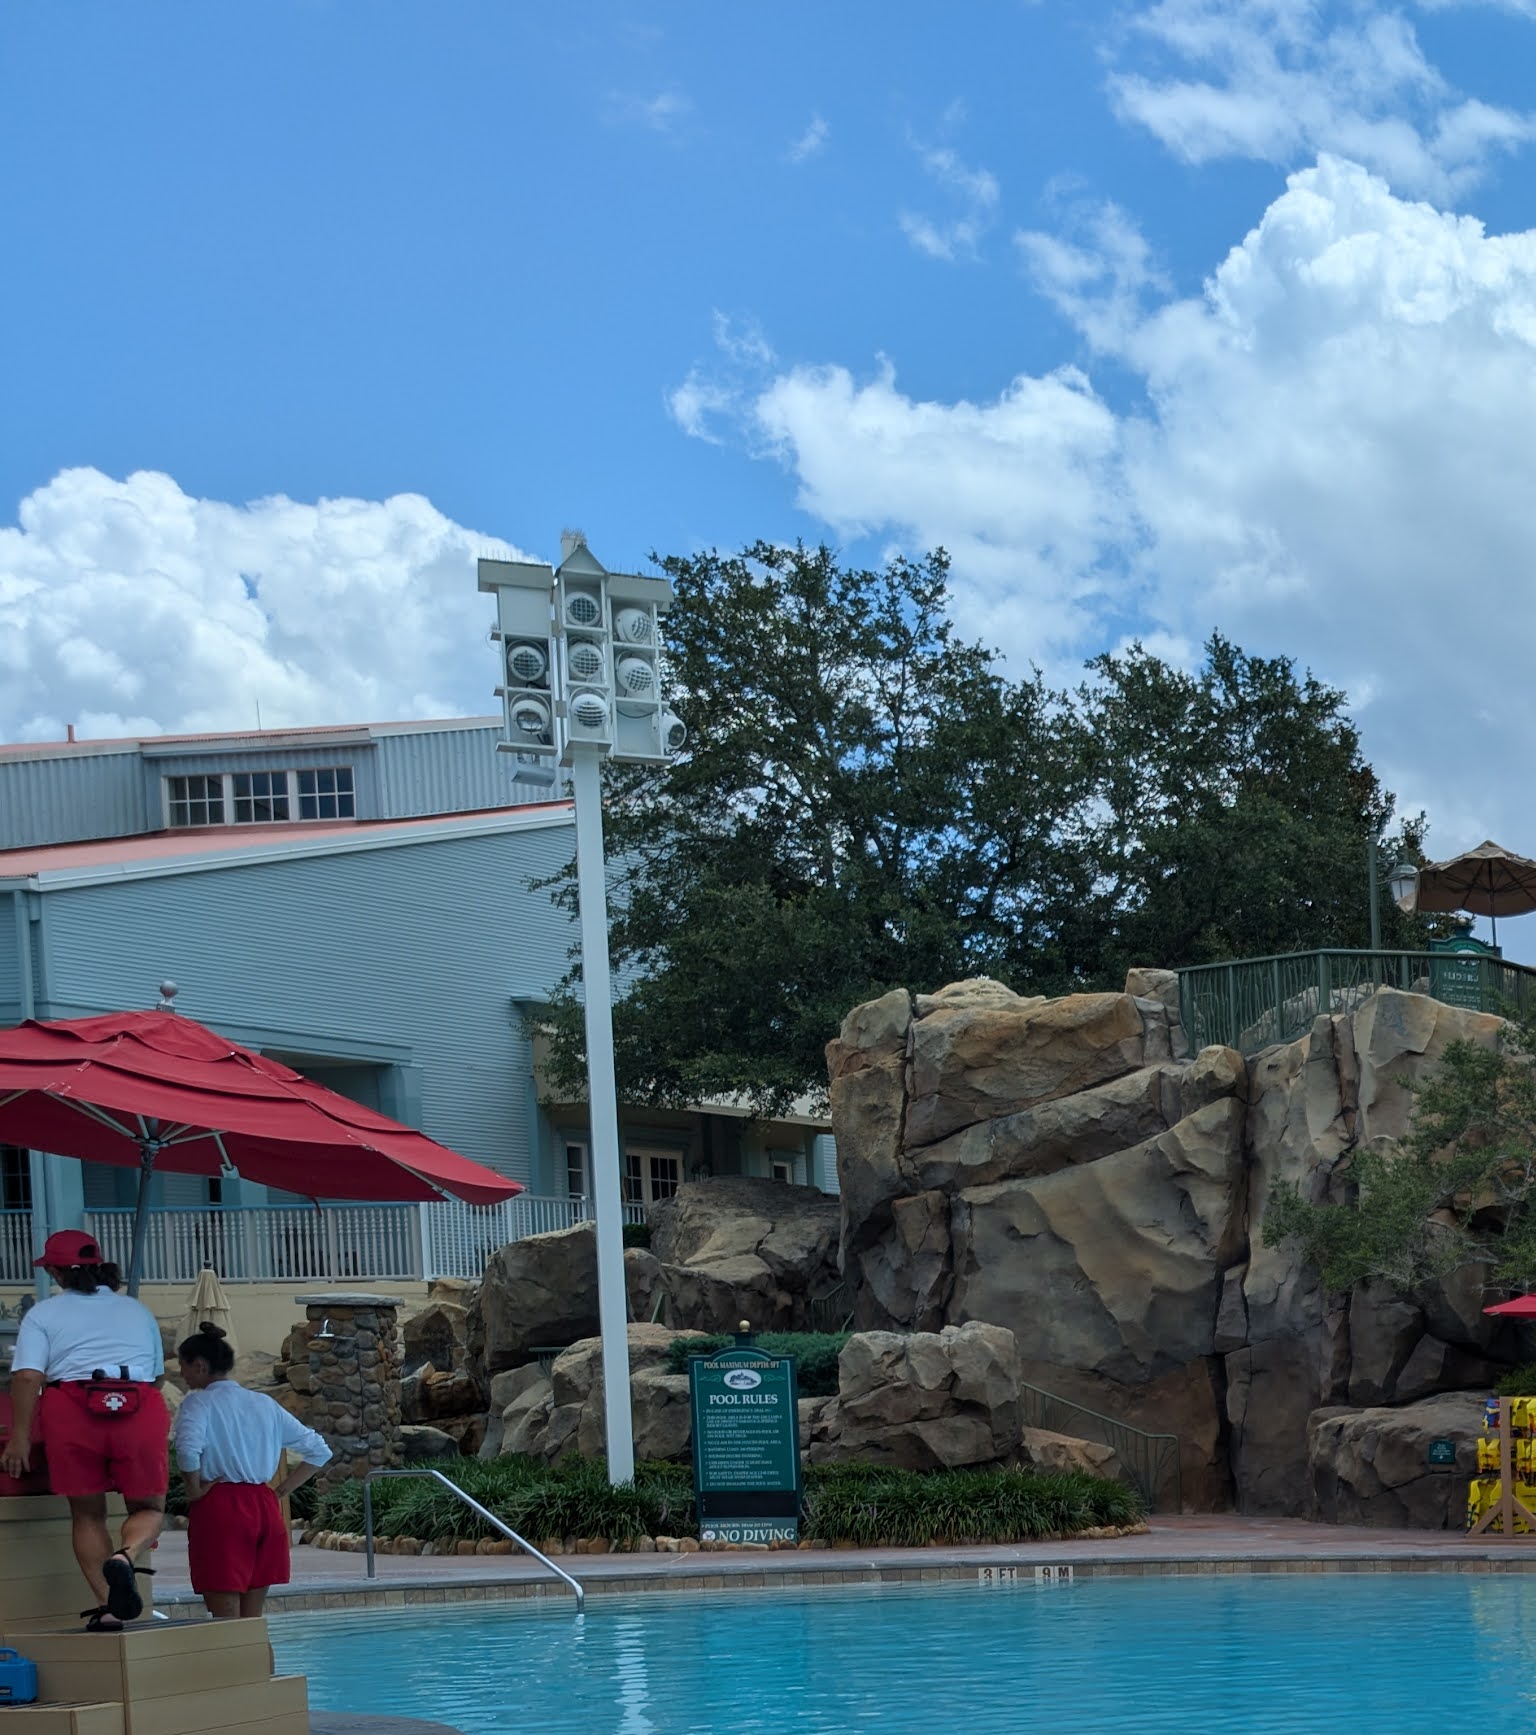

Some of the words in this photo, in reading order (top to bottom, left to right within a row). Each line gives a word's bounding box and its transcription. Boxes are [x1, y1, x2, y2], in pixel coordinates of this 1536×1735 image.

[704, 1361, 719, 1369] POOL
[720, 1361, 749, 1369] MAXIMUM
[709, 1394, 741, 1405] POOL
[742, 1394, 778, 1405] RULES
[719, 1529, 740, 1542] NO
[743, 1528, 795, 1541] DIVING
[999, 1567, 1015, 1579] FT
[1058, 1566, 1070, 1578] M
